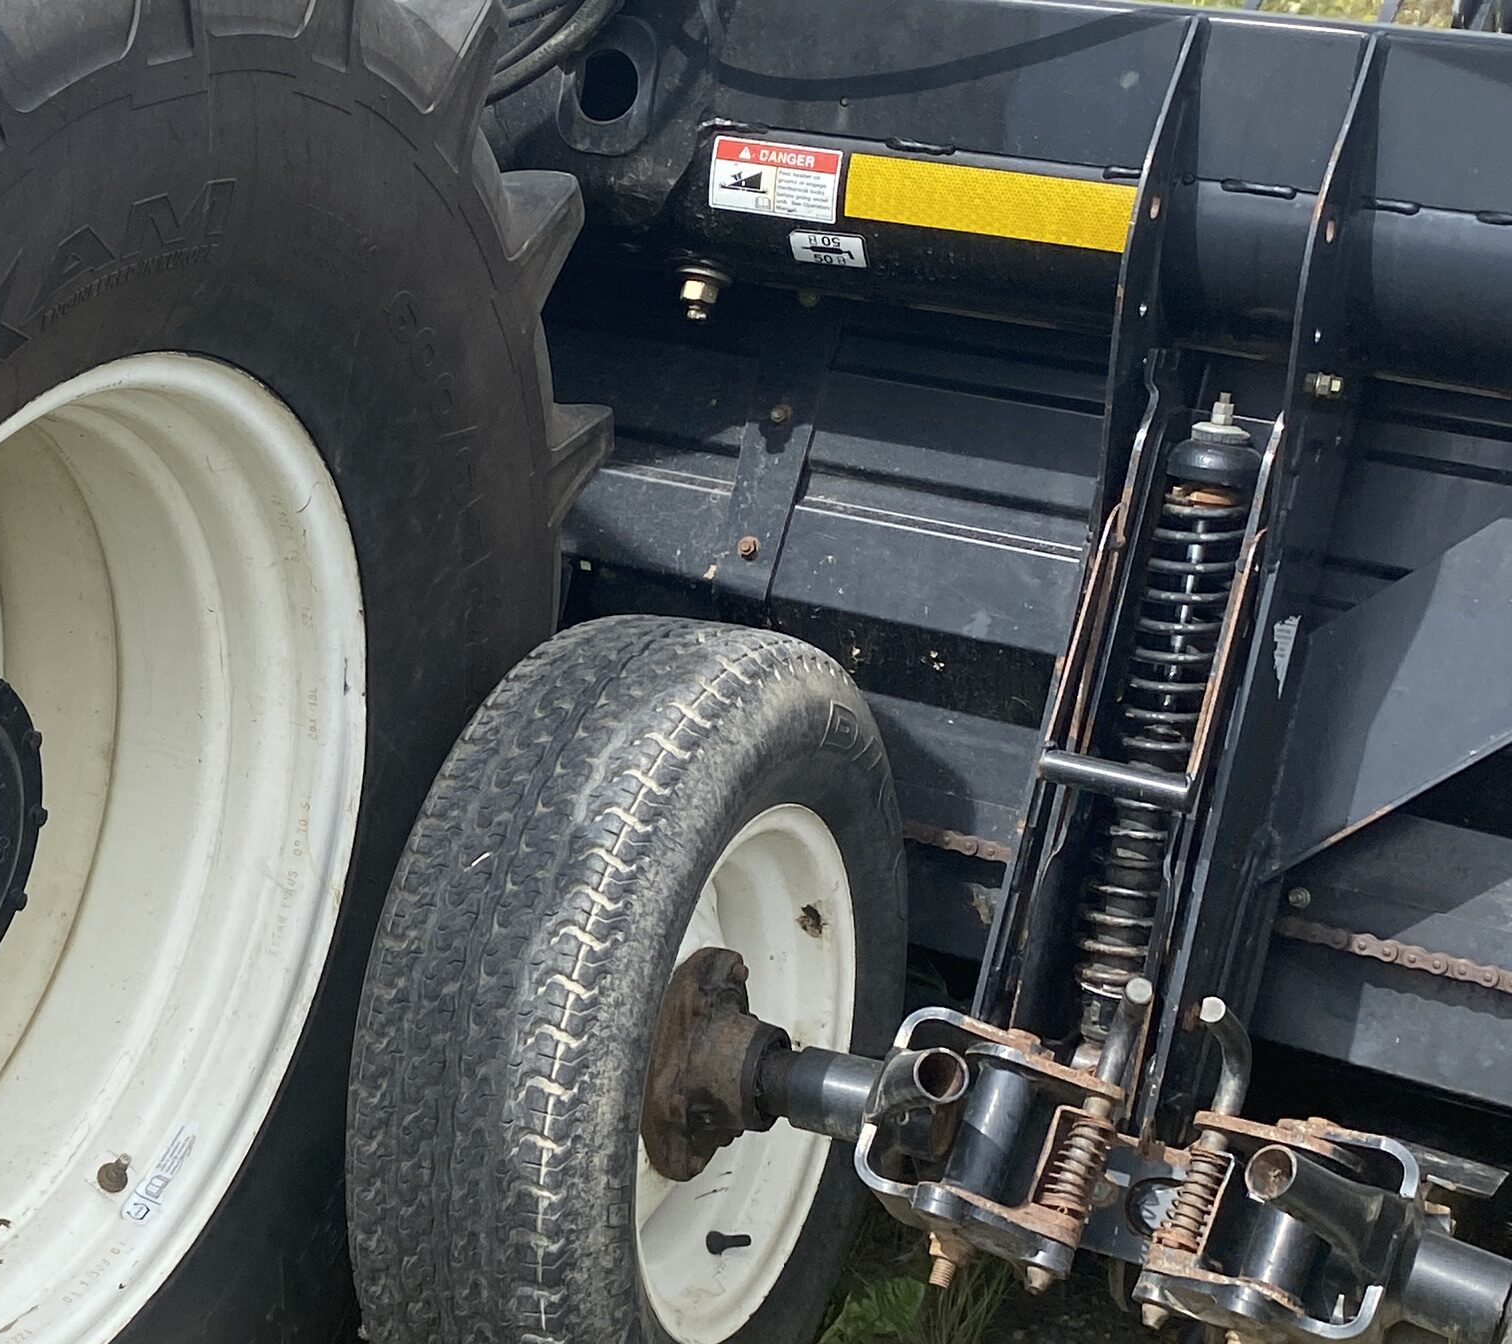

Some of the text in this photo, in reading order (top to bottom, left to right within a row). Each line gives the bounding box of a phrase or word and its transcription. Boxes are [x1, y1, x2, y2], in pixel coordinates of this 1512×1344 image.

[759, 149, 815, 168] DANGER
[821, 236, 841, 248] 50
[813, 253, 833, 264] 50
